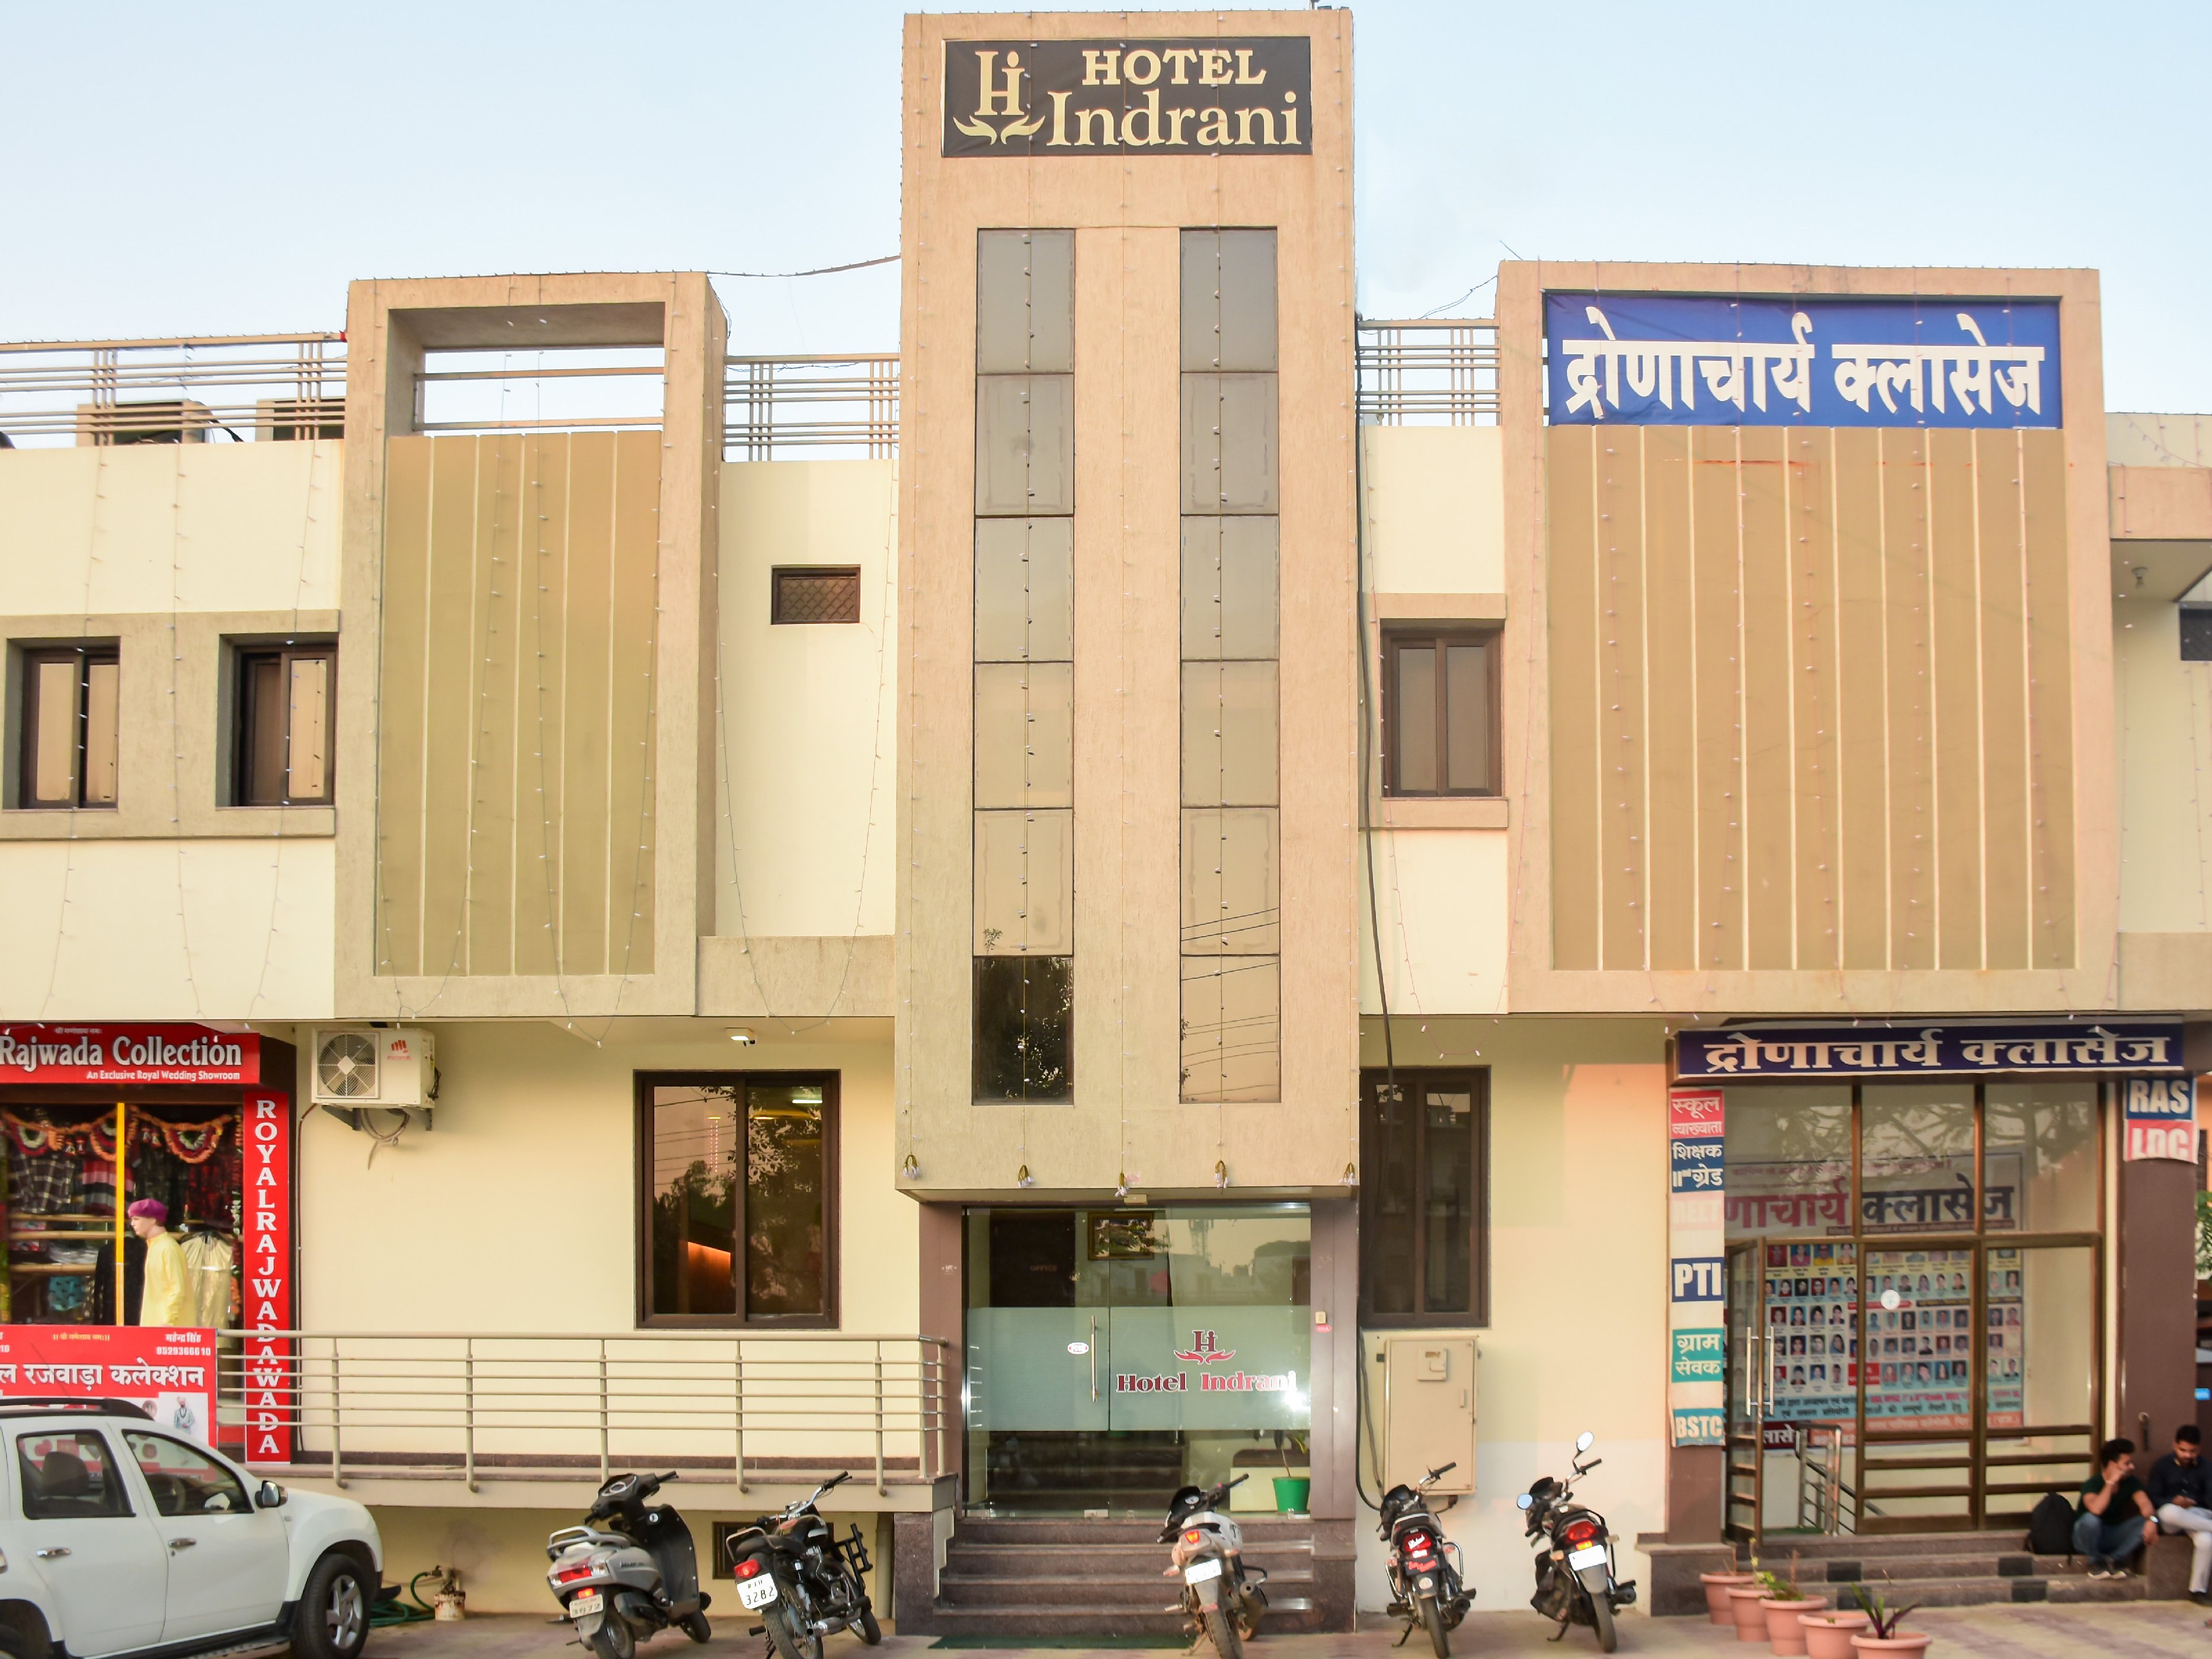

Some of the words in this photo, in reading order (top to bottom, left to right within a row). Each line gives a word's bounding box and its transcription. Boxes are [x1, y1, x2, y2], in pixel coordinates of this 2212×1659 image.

[1081, 48, 1267, 85] HOTEL
[1046, 90, 1302, 146] Indrani
[1562, 306, 1815, 419] द्रोणाचार्य
[1831, 313, 2045, 415] क्लासेज
[0, 1036, 103, 1072] Rajwada
[113, 1036, 242, 1065] Collection
[1704, 1029, 1943, 1074] द्रोणाचार्य
[1961, 1030, 2171, 1066] क्लासेज
[87, 1071, 98, 1080] An
[100, 1070, 135, 1080] Exclusive
[137, 1070, 159, 1081] Royal
[162, 1070, 196, 1081] Wedding
[199, 1071, 239, 1080] Showroom
[1672, 1097, 1720, 1119] स्कूल
[2129, 1080, 2189, 1114] RAS
[1672, 1121, 1722, 1136] व्याख्याता
[2131, 1128, 2189, 1160] LDC
[1672, 1142, 1723, 1160] शिक्षक
[1724, 1176, 1849, 1228] णाचार्य
[1862, 1172, 2014, 1224] क्लासेज
[1674, 1262, 1721, 1297] PTI
[1676, 1334, 1721, 1354] ग्राम
[23, 1364, 103, 1391] रजवाड़ा
[109, 1357, 205, 1387] कलेक्शन
[1116, 1372, 1188, 1392] Hotel
[1201, 1370, 1298, 1392] Indrani
[1676, 1356, 1721, 1376] सेवक
[1676, 1415, 1723, 1439] BSTC
[746, 1586, 775, 1606] 3282
